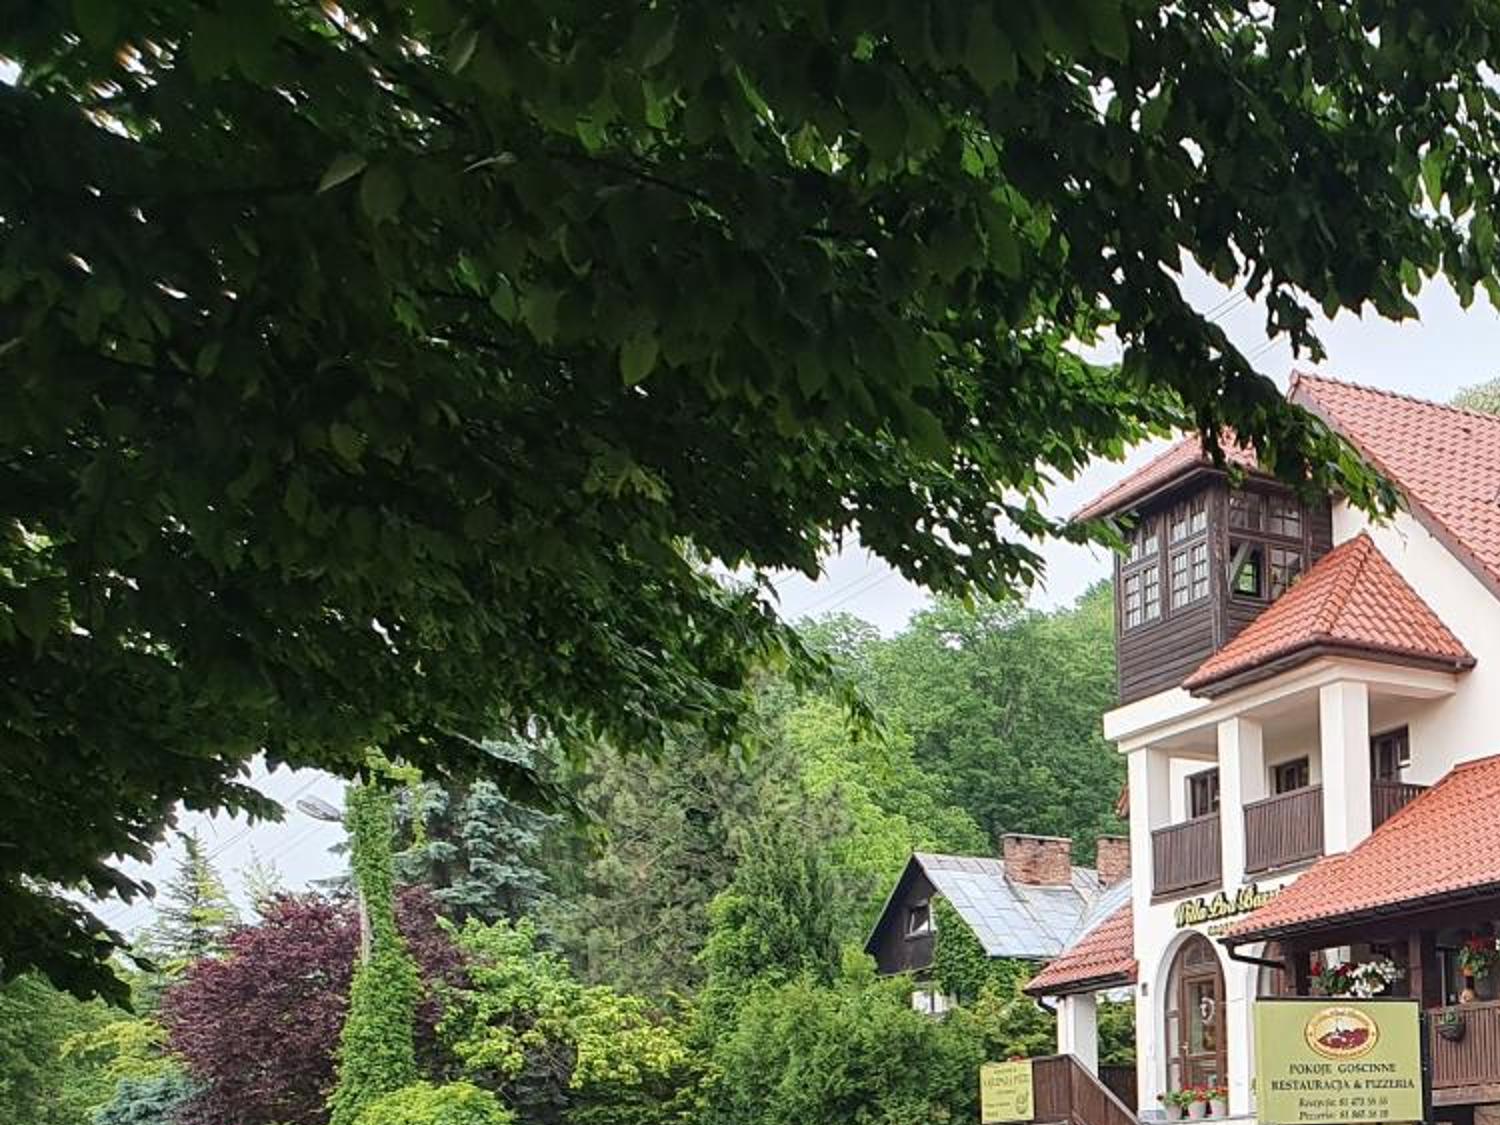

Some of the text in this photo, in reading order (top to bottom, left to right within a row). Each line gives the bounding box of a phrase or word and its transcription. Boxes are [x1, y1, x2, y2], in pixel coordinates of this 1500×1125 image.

[1289, 1063, 1332, 1075] POKOJE
[1271, 1079, 1350, 1092] RESTAURACJA
[1365, 1078, 1415, 1090] PIZZERIA
